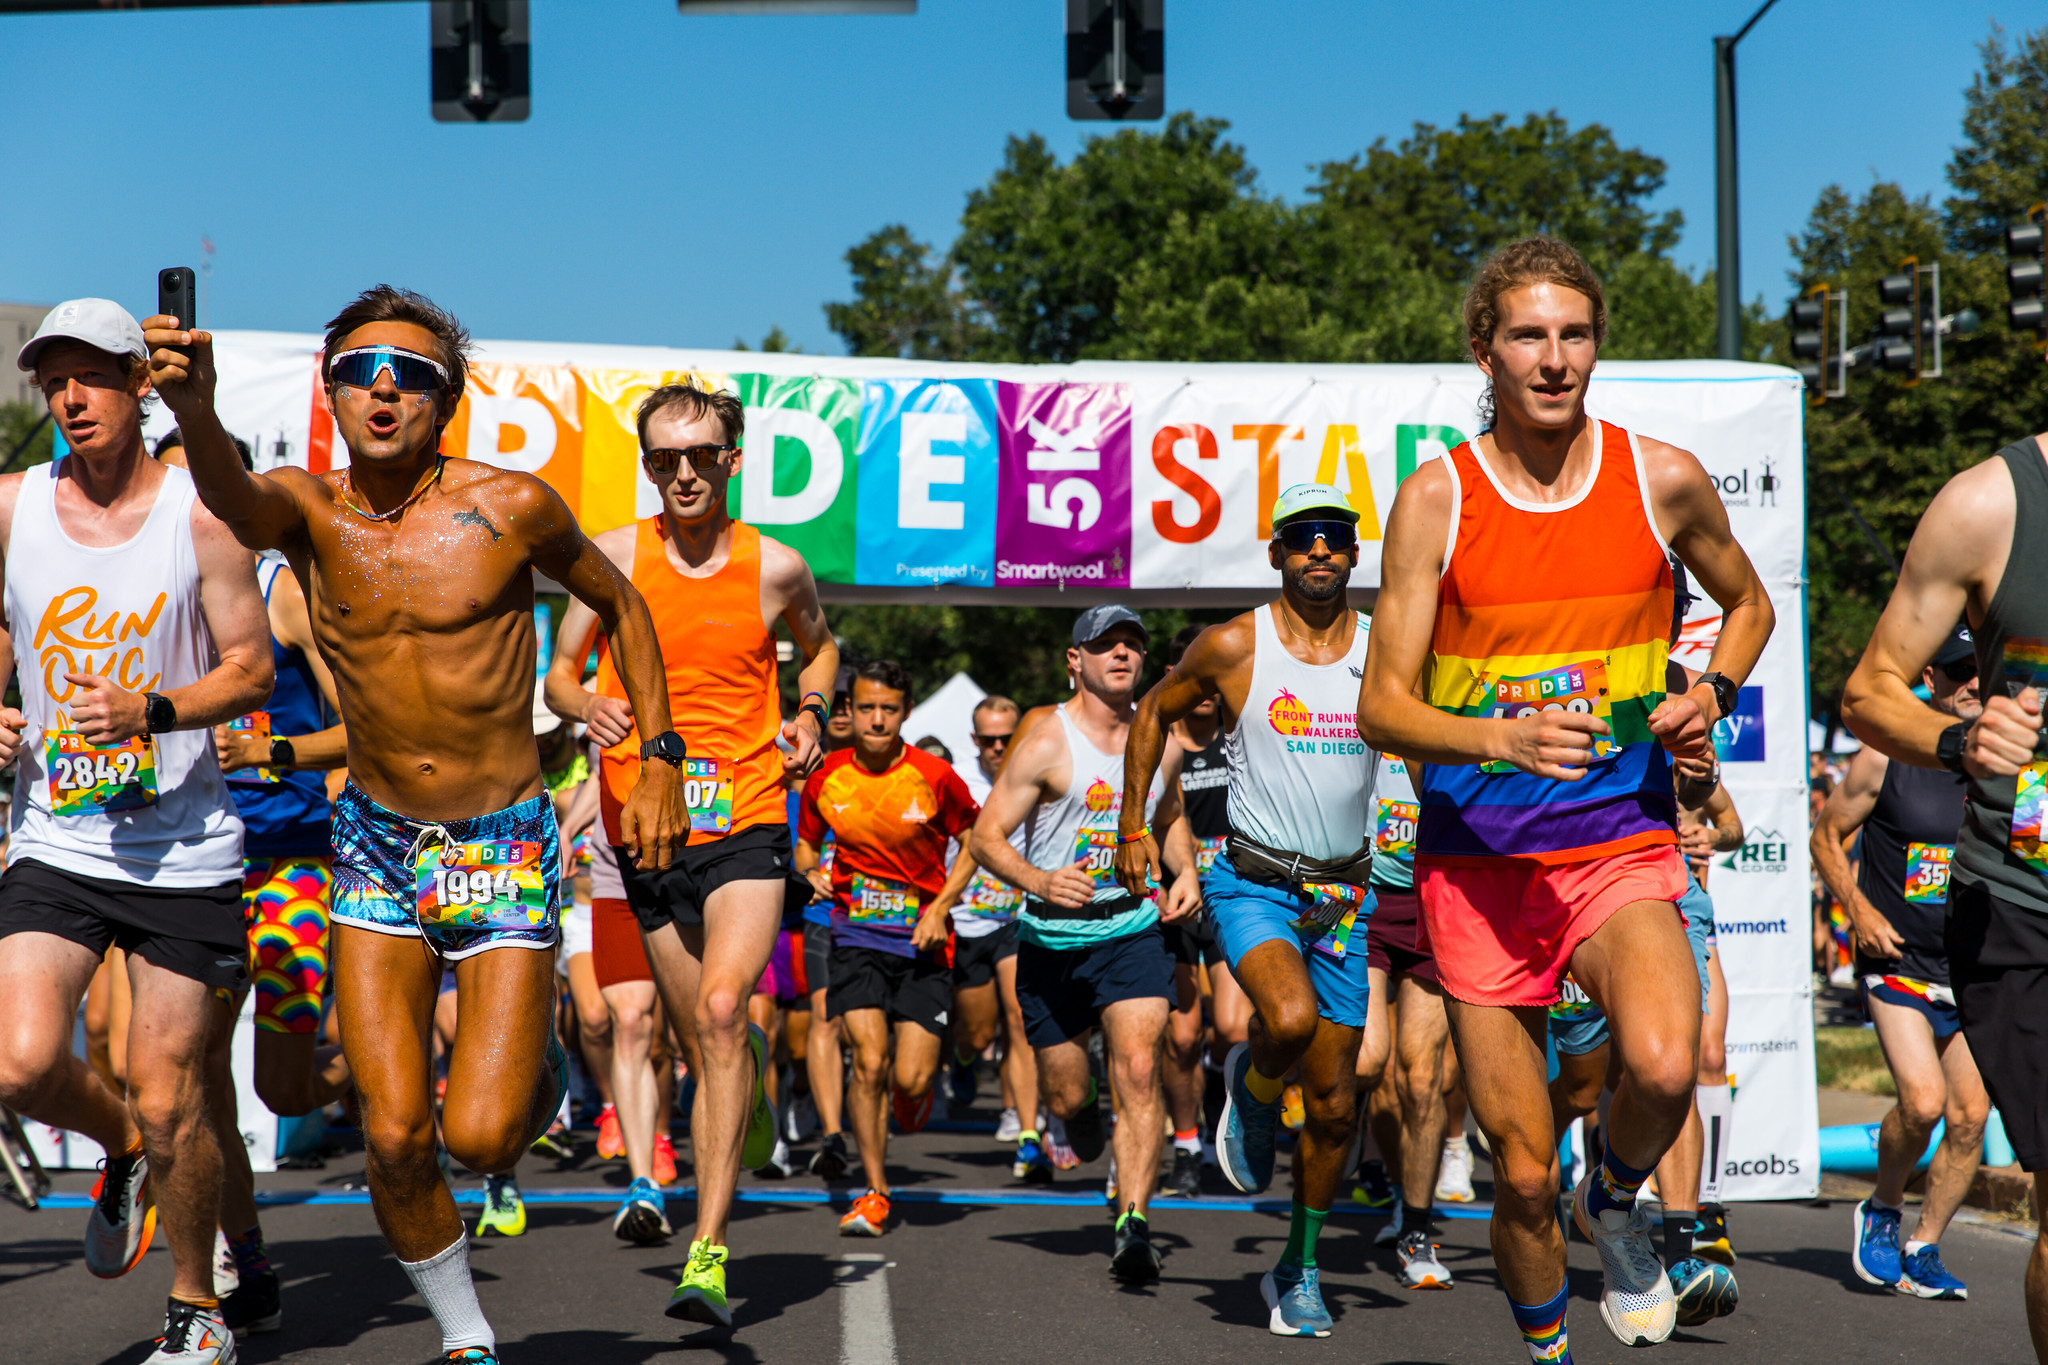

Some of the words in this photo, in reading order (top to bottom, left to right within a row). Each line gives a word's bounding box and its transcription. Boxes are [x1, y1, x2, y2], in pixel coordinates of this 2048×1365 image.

[1026, 414, 1102, 532] 5K
[896, 563, 968, 578] Presented
[970, 564, 988, 581] by
[996, 559, 1105, 580] Smartwool
[1498, 675, 1568, 698] PRIDE
[1572, 672, 1583, 688] 5K
[1275, 710, 1314, 723] FRONT
[1291, 725, 1299, 736] &
[1302, 727, 1359, 738] WALKERS
[1286, 740, 1316, 754] SAN
[1321, 742, 1365, 755] DIEGO
[54, 751, 142, 790] 2842
[1389, 764, 1408, 775] SA
[1090, 833, 1118, 843] PRI
[1385, 818, 1418, 844] 30
[440, 847, 506, 862] RIDE
[511, 847, 519, 861] 5K
[1741, 843, 1786, 862] REI
[432, 869, 521, 906] 1994
[860, 889, 906, 912] 1553
[1724, 1153, 1799, 1176] acobs
